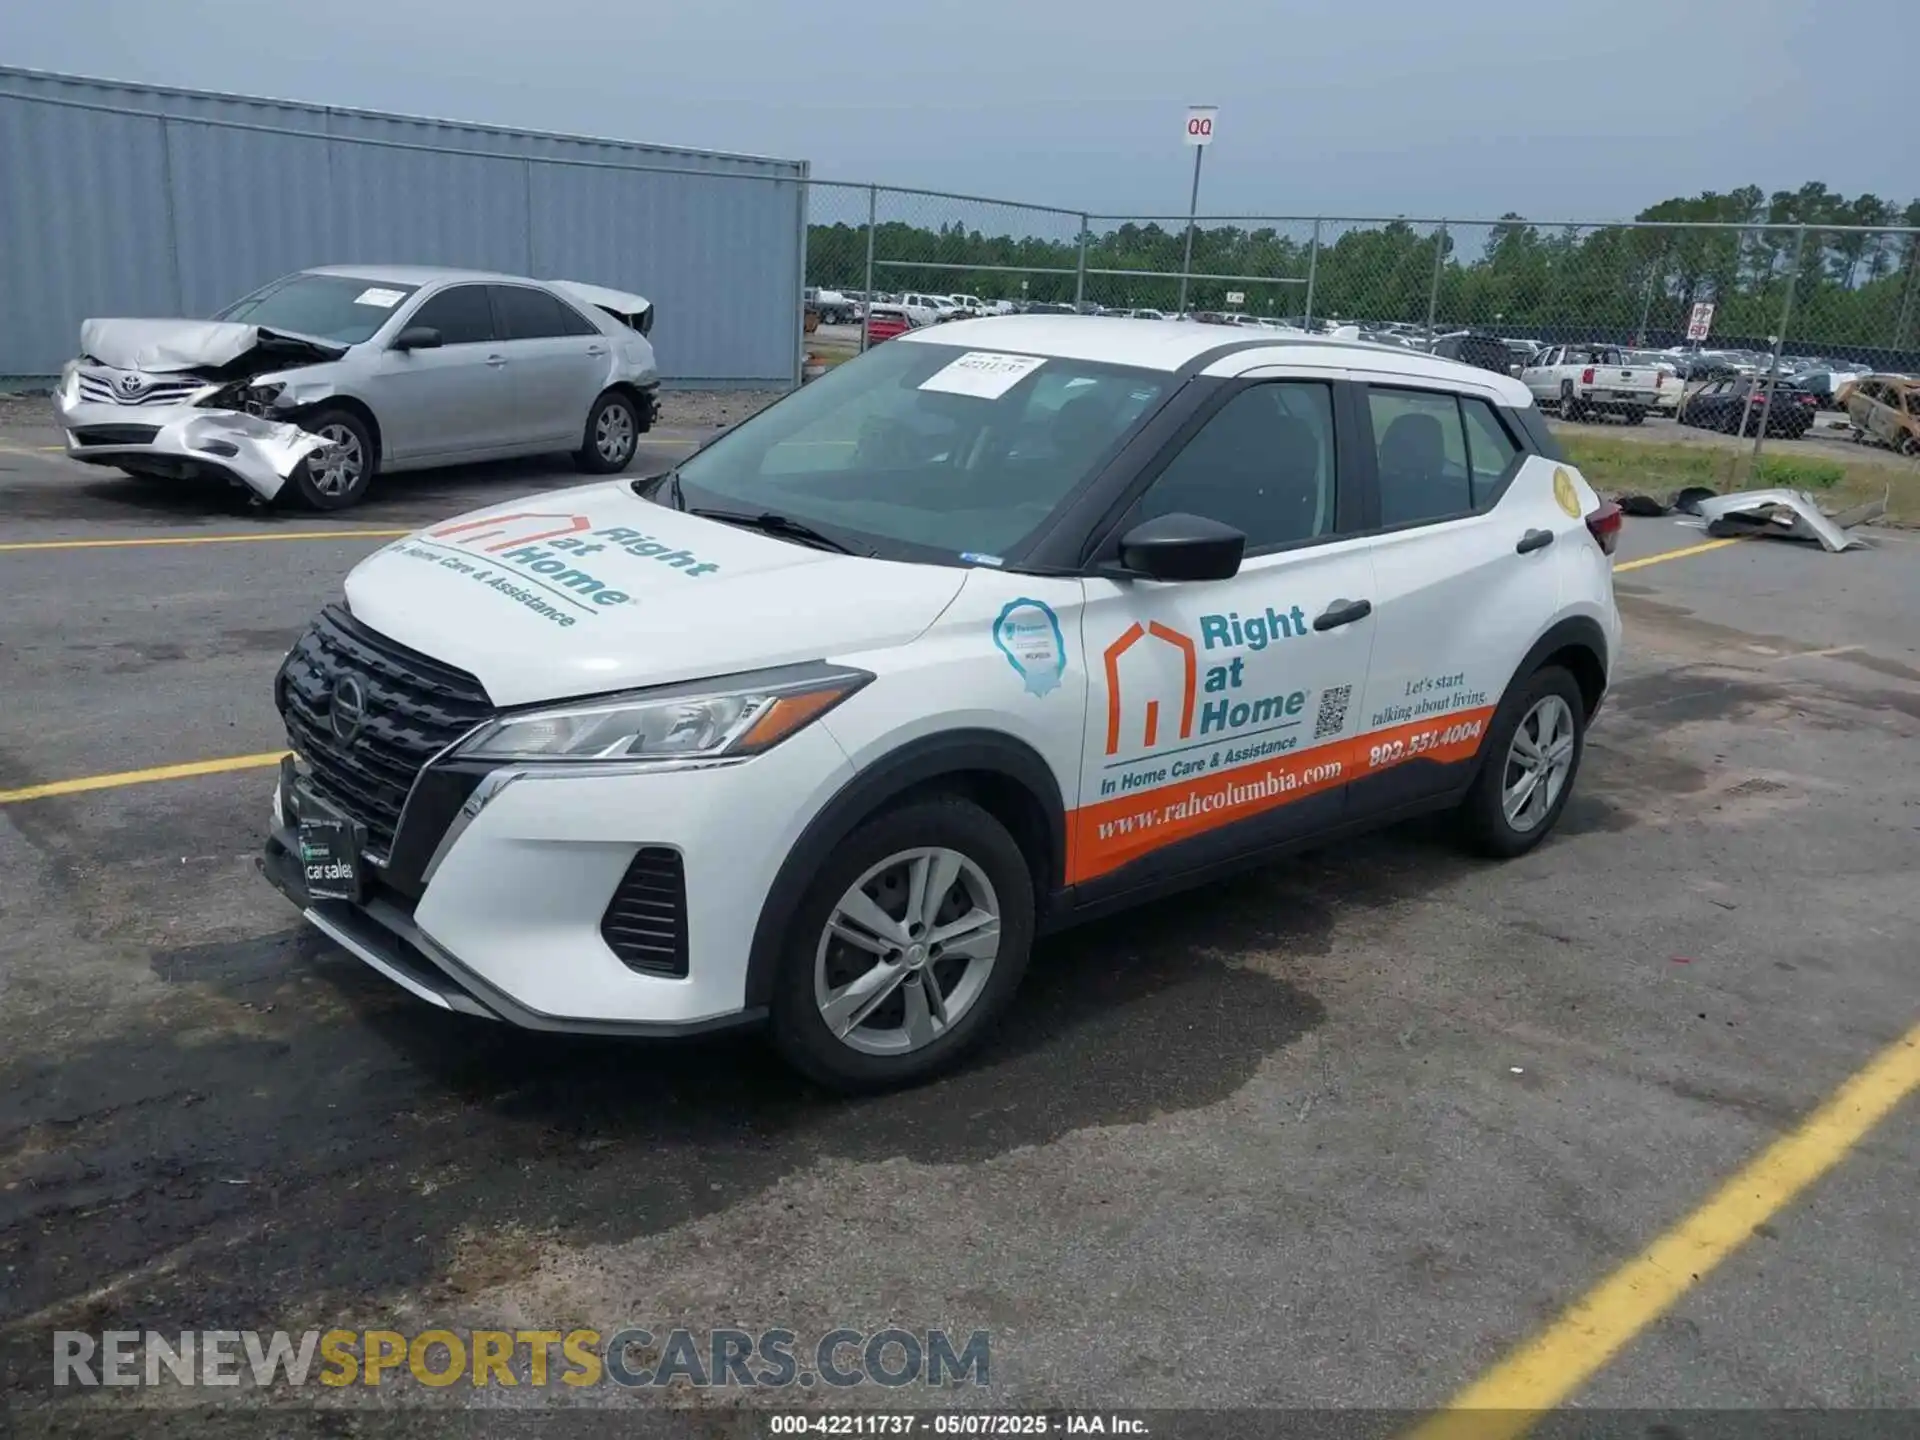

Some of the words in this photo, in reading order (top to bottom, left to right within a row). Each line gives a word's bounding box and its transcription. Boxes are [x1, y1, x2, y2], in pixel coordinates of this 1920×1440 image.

[1188, 118, 1212, 136] QQ
[547, 537, 605, 557] at
[592, 527, 720, 578] Right
[440, 557, 476, 574] Care
[472, 570, 493, 581] &
[485, 577, 577, 628] Assistance
[501, 546, 631, 606] Home
[1199, 605, 1308, 651] Right
[1204, 656, 1245, 693] at
[1404, 677, 1433, 697] Let's
[1434, 671, 1465, 690] start
[1199, 690, 1306, 735] Home
[1371, 702, 1413, 728] talking
[1414, 695, 1451, 716] about
[1100, 778, 1117, 796] In
[1120, 767, 1168, 791] Home
[1171, 759, 1206, 778] Care
[1209, 751, 1220, 768] &
[1223, 736, 1298, 765] Assistance
[1097, 758, 1343, 840] www.rahcolumbia.com
[307, 864, 323, 880] car
[324, 857, 353, 879] sales
